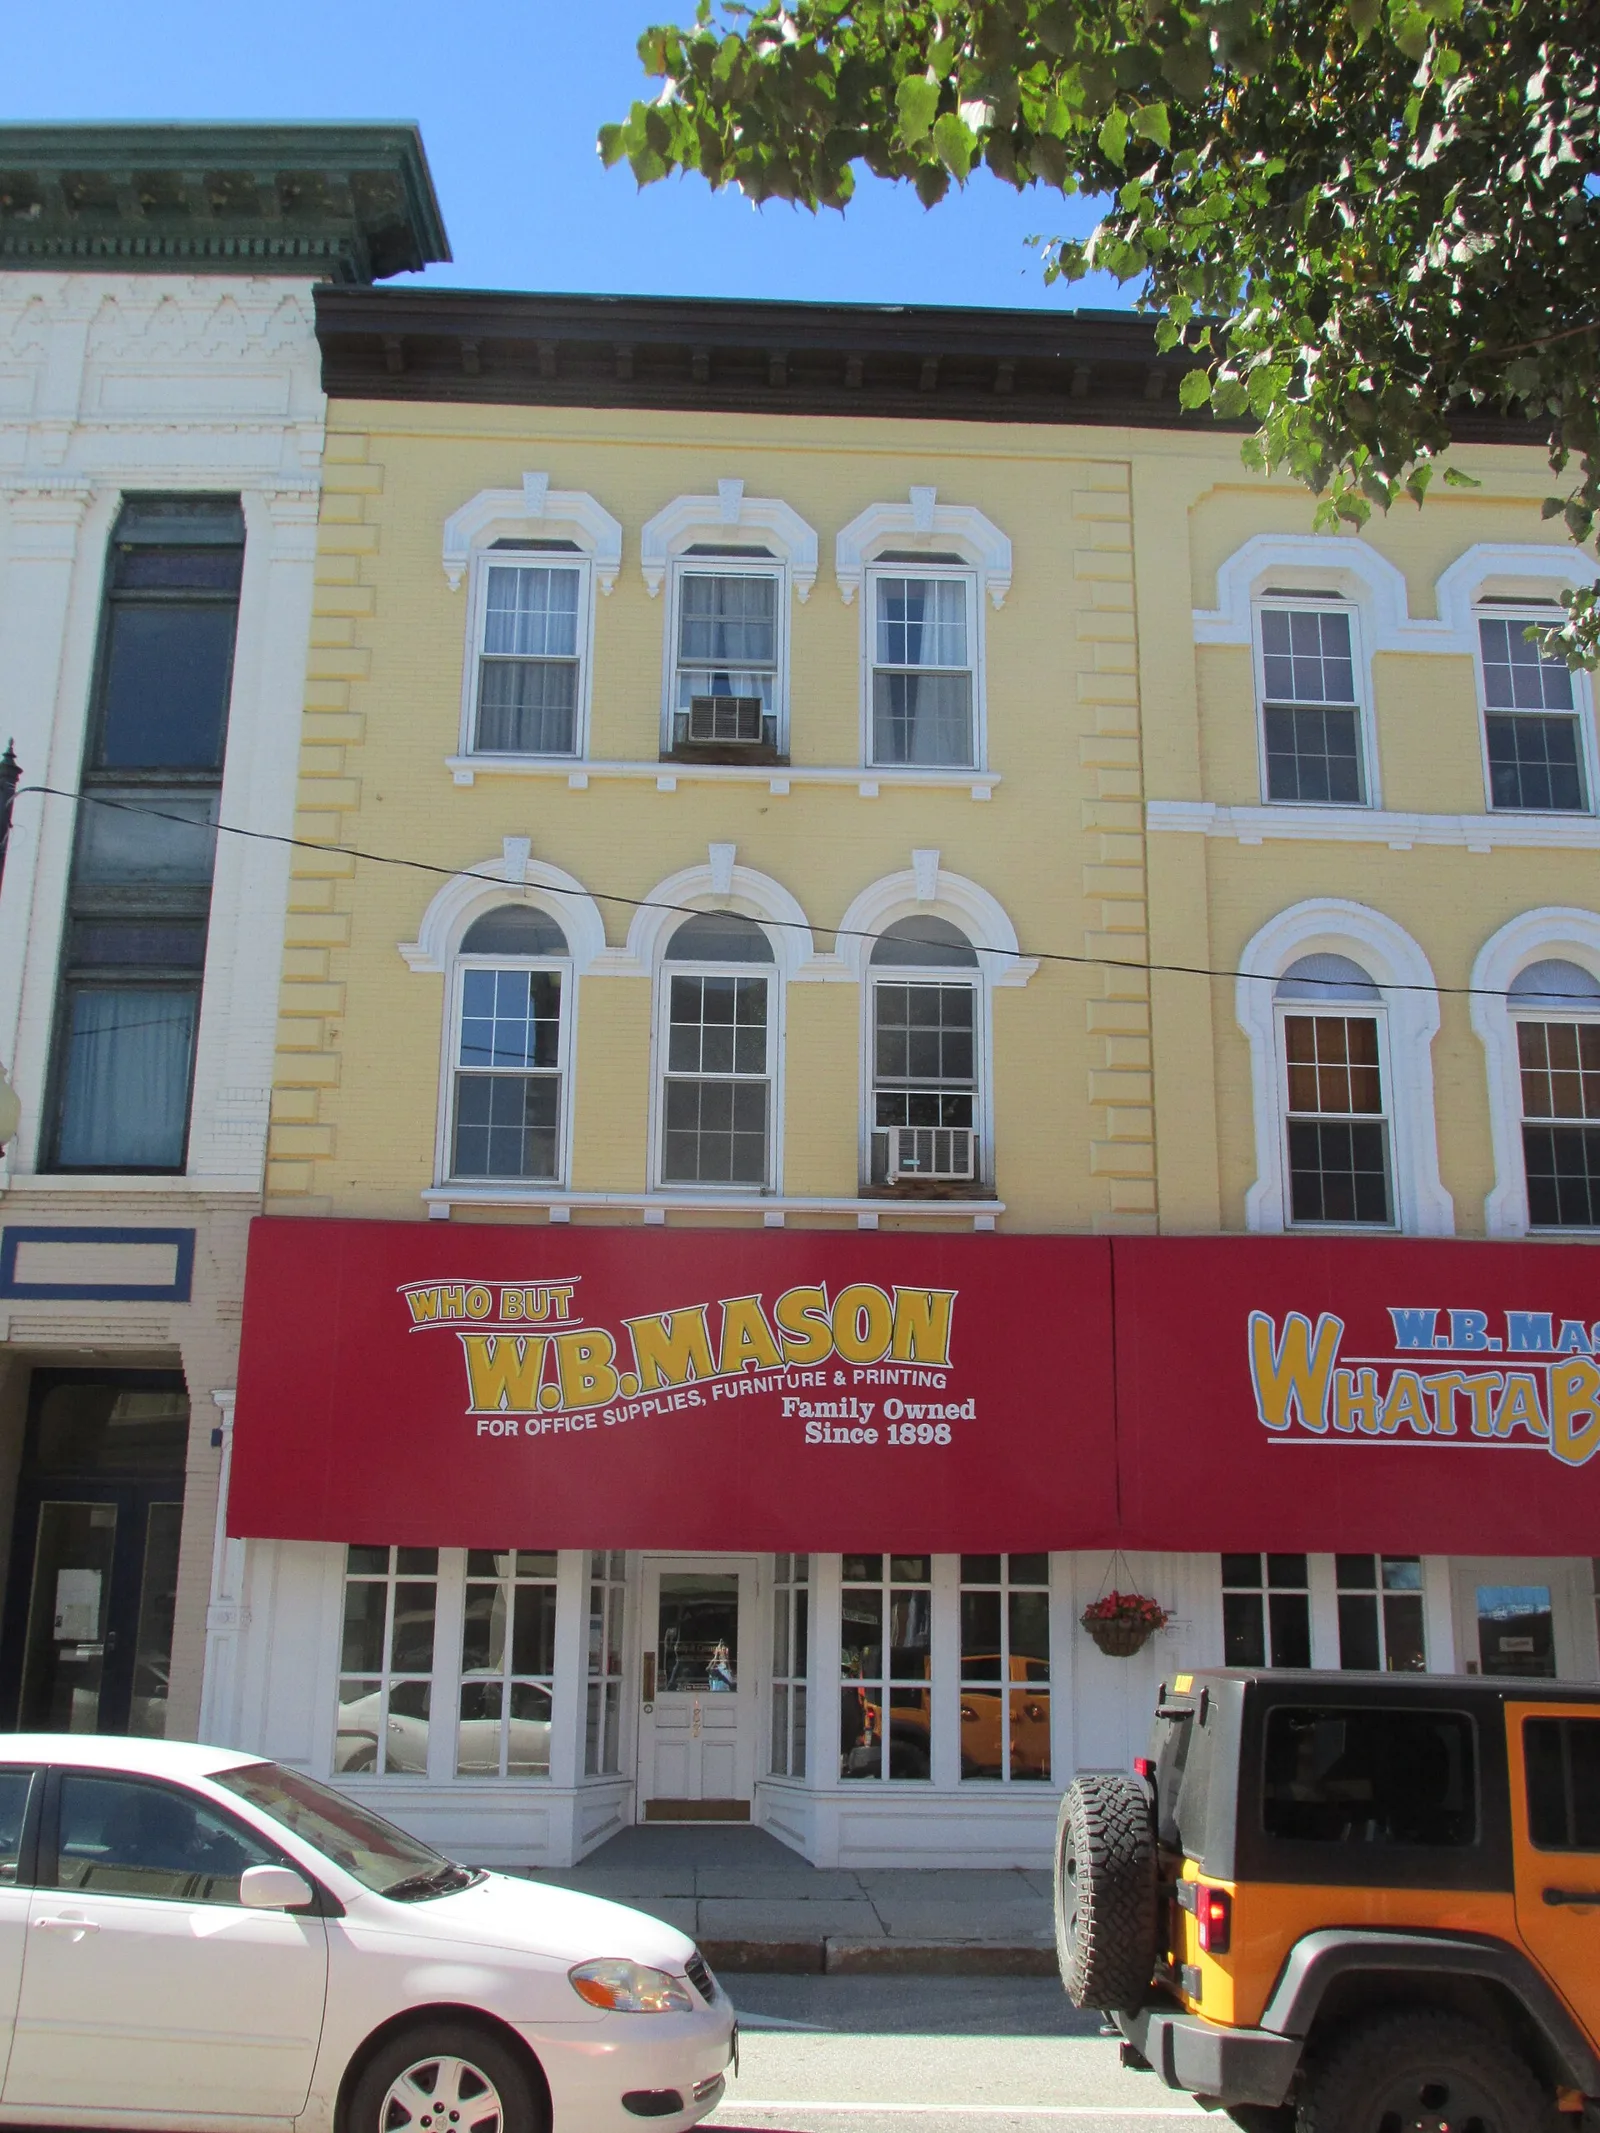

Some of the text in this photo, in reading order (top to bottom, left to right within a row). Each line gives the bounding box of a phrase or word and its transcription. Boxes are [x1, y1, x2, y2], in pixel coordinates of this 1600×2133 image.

[405, 1286, 574, 1323] WHO BUT
[477, 1369, 948, 1437] FOR OFFICE SUPPLIES, FURNITURE & PRINTING
[781, 1397, 977, 1424] Family Owned
[805, 1422, 953, 1447] Since 1898
